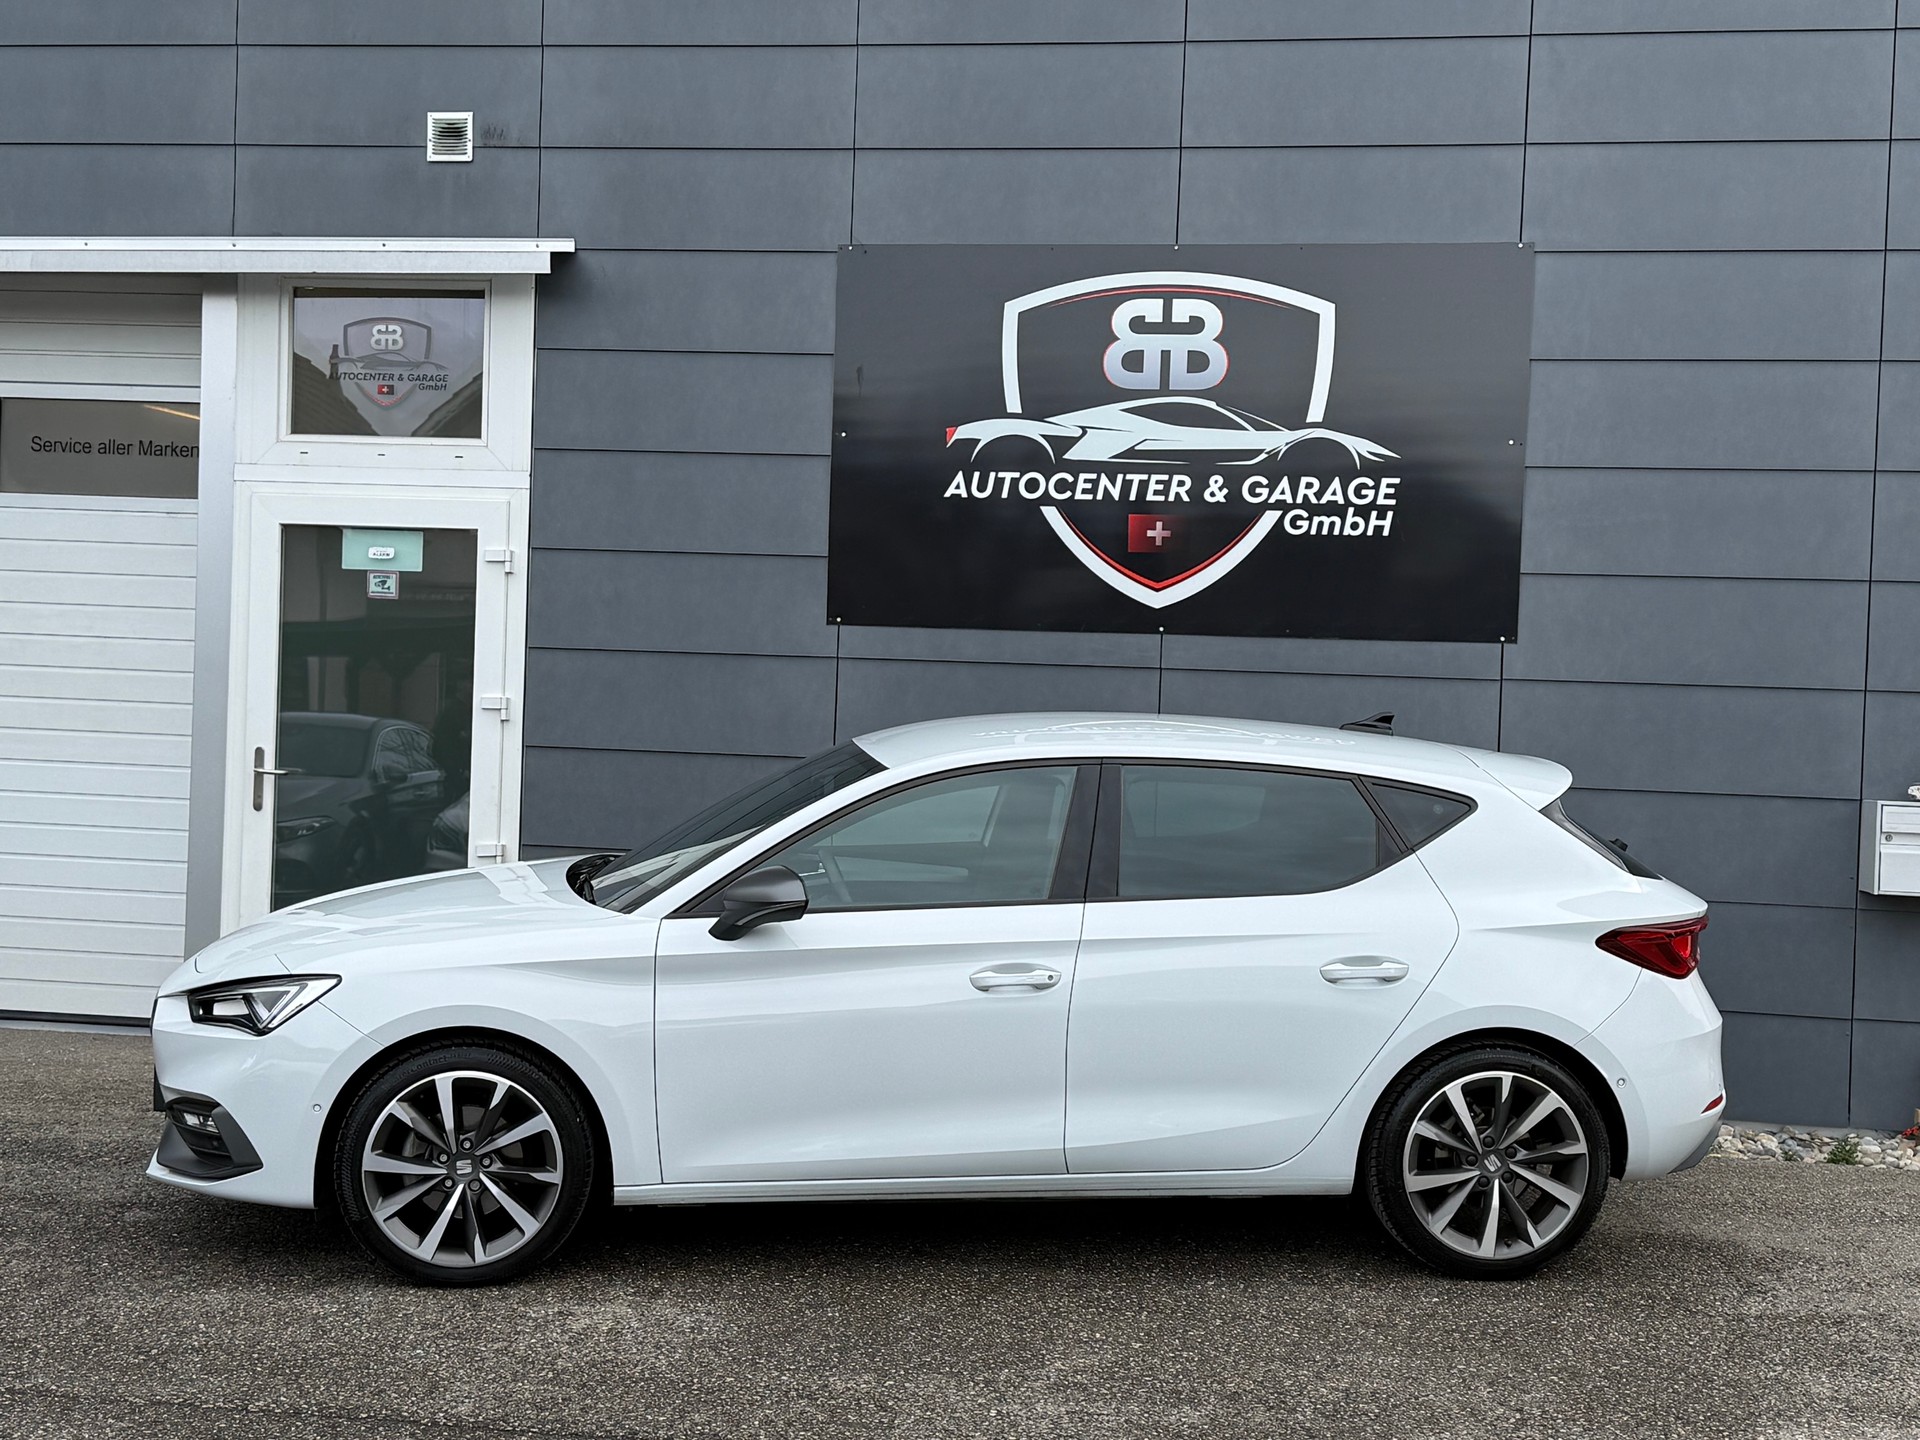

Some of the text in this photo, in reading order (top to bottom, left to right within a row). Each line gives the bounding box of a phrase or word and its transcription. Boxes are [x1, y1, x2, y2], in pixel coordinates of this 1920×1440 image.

[397, 374, 405, 382] &
[407, 373, 449, 383] GARAGE
[418, 382, 448, 392] GmbH
[30, 435, 200, 458] Service aller Marken
[943, 470, 1401, 506] AUTOCENTER & GARAGE
[1283, 508, 1394, 537] GmbH
